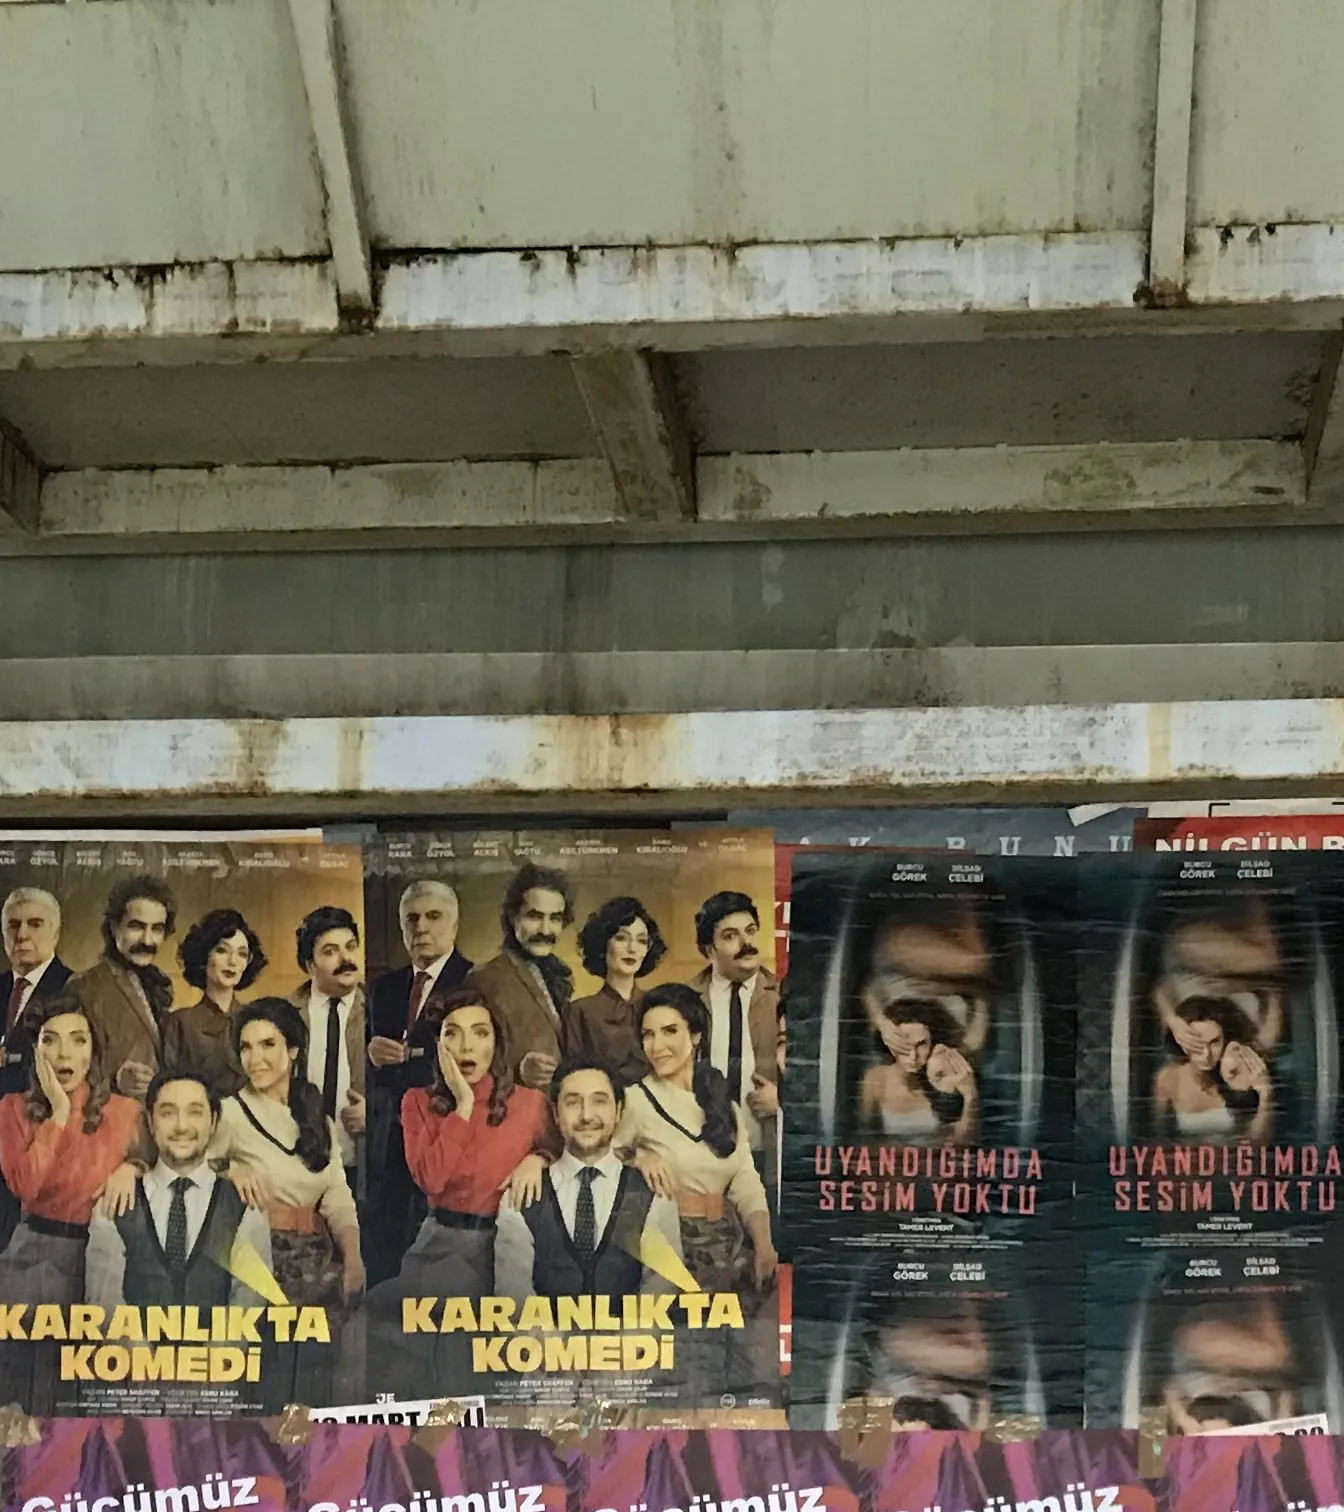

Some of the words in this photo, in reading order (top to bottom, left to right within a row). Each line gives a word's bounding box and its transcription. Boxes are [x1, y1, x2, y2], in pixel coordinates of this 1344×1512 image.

[1180, 869, 1215, 879] GÖREK
[1236, 868, 1273, 880] ÇELEBİ
[815, 1142, 1043, 1181] UYANDIĞIMDA
[1109, 1140, 1342, 1177] UYANDIĞIMDA
[933, 1182, 1036, 1215] YOKTU
[1232, 1180, 1336, 1213] YOKTU
[402, 1293, 745, 1334] KARANLIKTA
